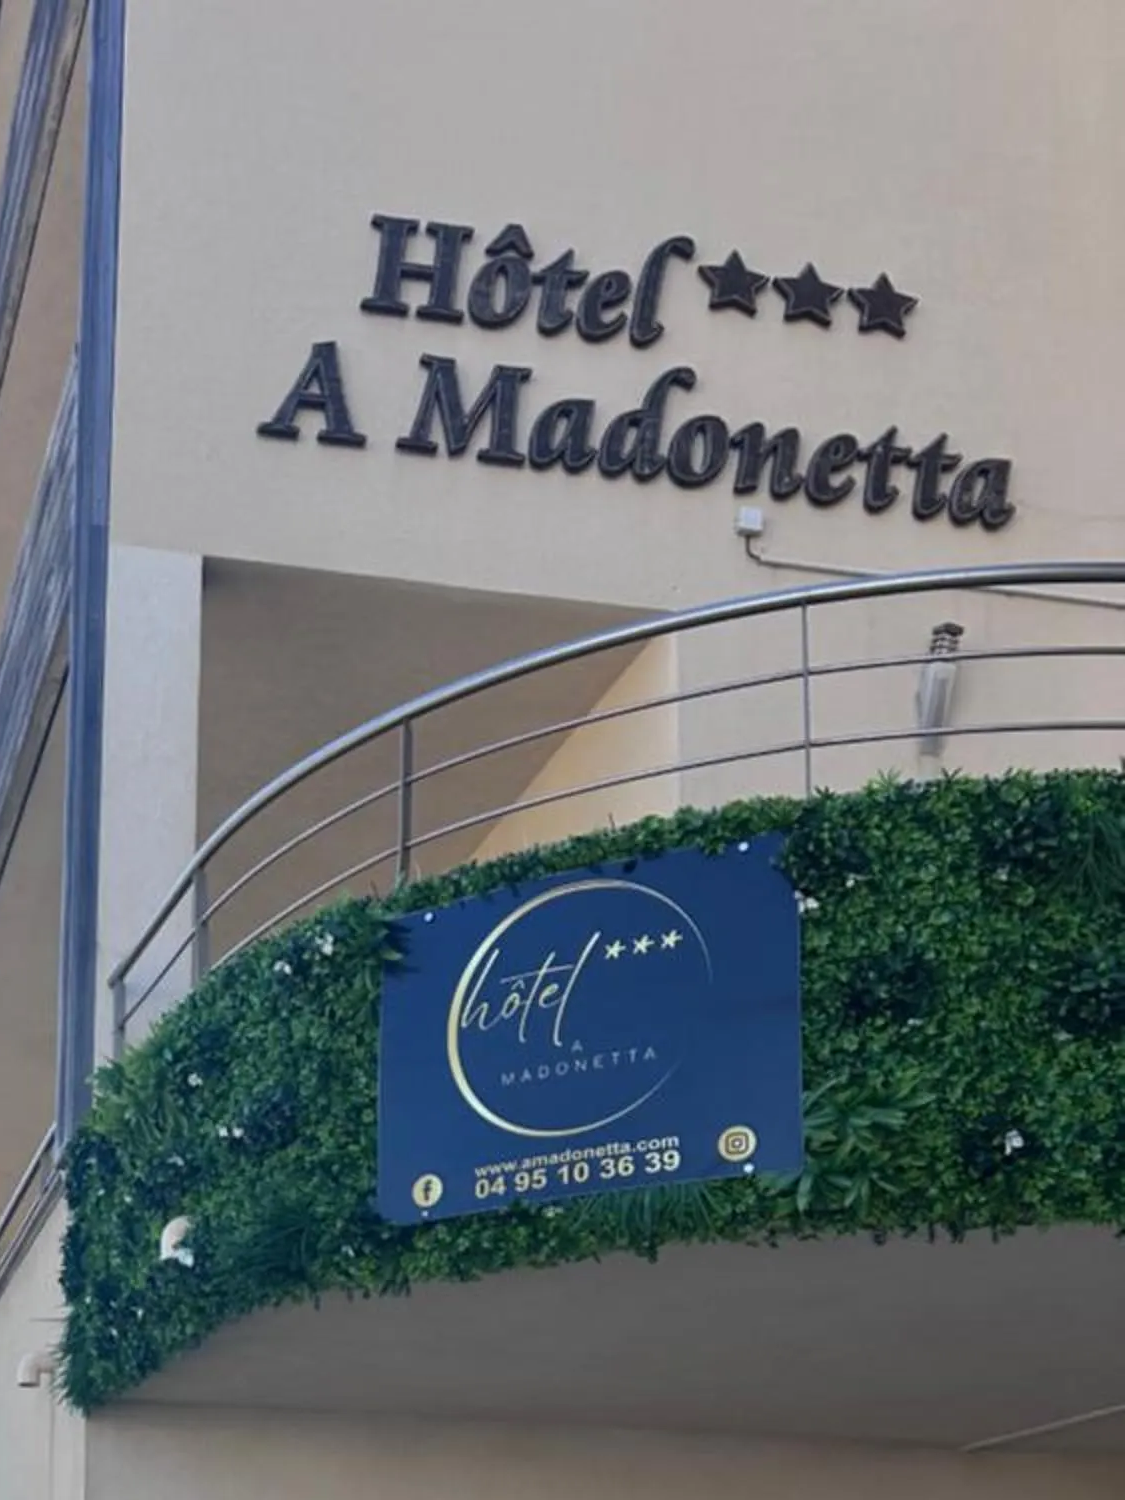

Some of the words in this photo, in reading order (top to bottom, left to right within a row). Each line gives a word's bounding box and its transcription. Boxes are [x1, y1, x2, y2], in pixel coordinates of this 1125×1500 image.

[360, 213, 696, 348] Hôtel
[257, 341, 367, 448] A
[395, 353, 1018, 531] Madonetta
[501, 1046, 658, 1086] MADONETTA
[571, 1039, 583, 1053] A
[475, 1135, 680, 1178] www.amadonetta.com
[475, 1175, 507, 1199] 04
[514, 1167, 548, 1193] 95
[557, 1161, 590, 1185] 10
[599, 1154, 635, 1180] 36
[644, 1149, 681, 1174] 39
